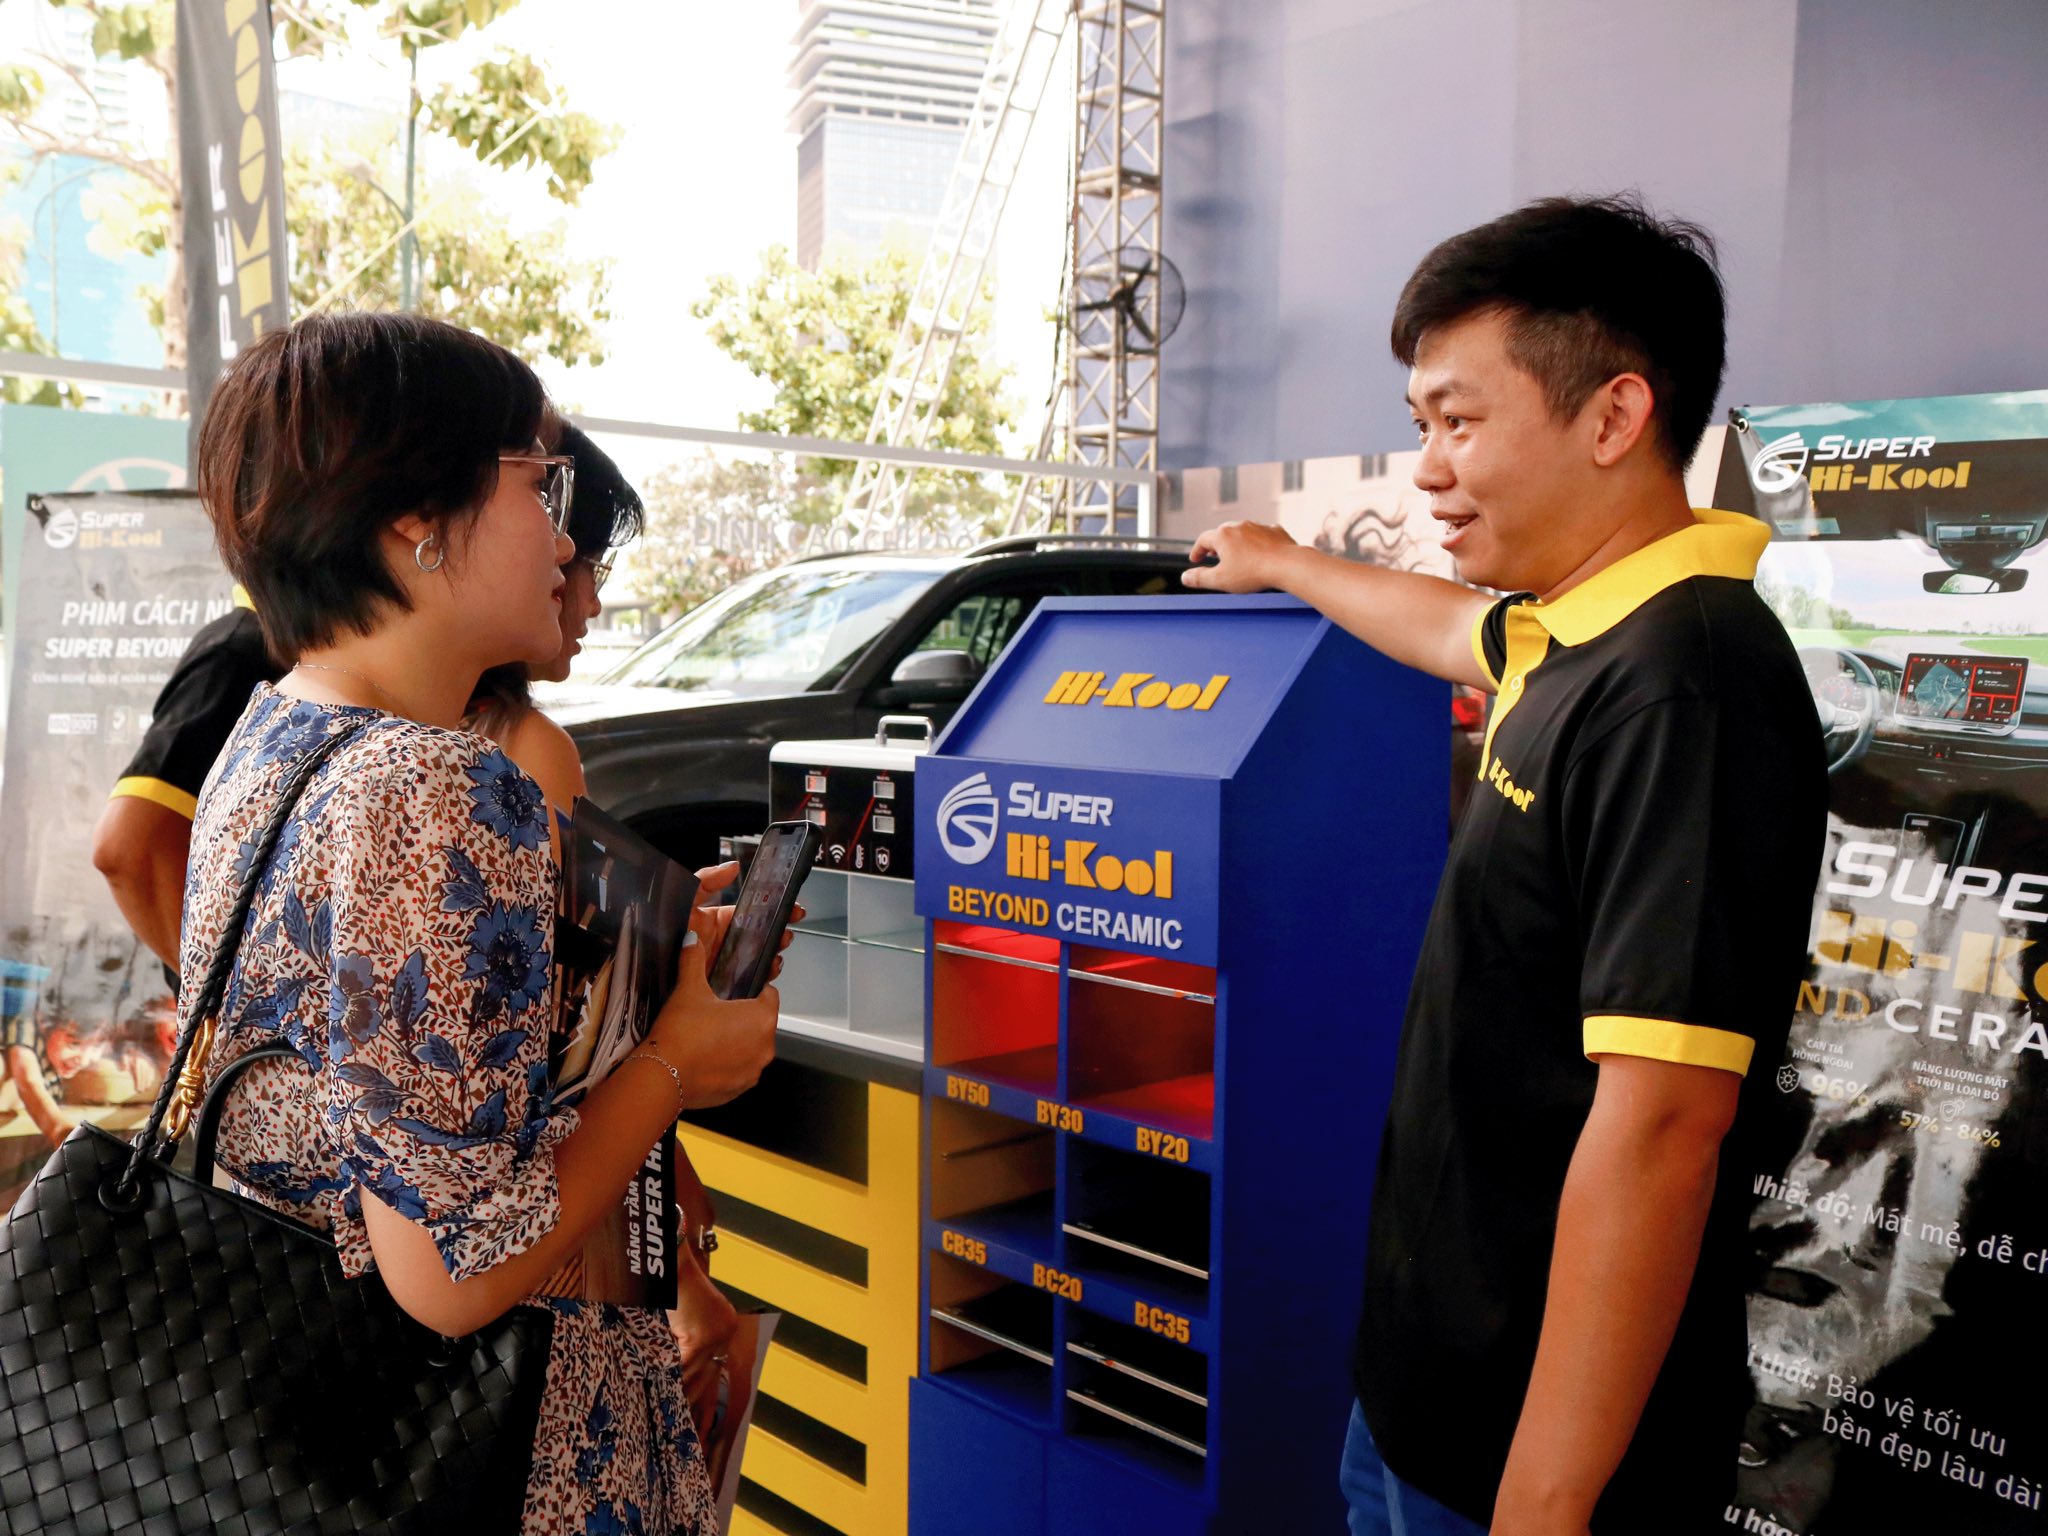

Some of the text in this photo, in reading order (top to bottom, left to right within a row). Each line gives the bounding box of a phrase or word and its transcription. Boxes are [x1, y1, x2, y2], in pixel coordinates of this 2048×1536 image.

[208, 142, 238, 360] PER
[1809, 461, 1972, 491] Hi-Kool
[1813, 435, 1936, 460] SUPER
[79, 511, 144, 529] SUPER
[61, 601, 127, 625] PHIM
[133, 594, 197, 625] CÁCH
[44, 637, 114, 658] SUPER
[1042, 671, 1231, 711] Hi-Kool
[1007, 781, 1114, 827] SUPER
[1007, 832, 1173, 899] Hi-Kool
[1826, 841, 2048, 923] SUPE
[949, 885, 1183, 950] BEYOND CERAMIC
[1811, 910, 2048, 1001] Hi-K
[1795, 980, 2048, 1060] ND CERA
[947, 1075, 1190, 1163] BY50 BY30 BY20
[1811, 1073, 1869, 1107] 96%
[1900, 1110, 1939, 1134] 57%
[1957, 1124, 2000, 1148] 84%
[626, 1219, 642, 1275] NÂNG
[646, 1176, 665, 1279] SUPER
[1863, 1204, 1912, 1237] Mát
[1977, 1234, 2014, 1263] dễ
[942, 1230, 1190, 1344] CB35 BC20 BC35
[1826, 1373, 1875, 1409] Bảo
[1884, 1397, 1915, 1429] vệ
[1923, 1408, 1961, 1441] tối
[1970, 1427, 2006, 1457] ưu
[1822, 1408, 2042, 1511] bền đẹp lâu dài
